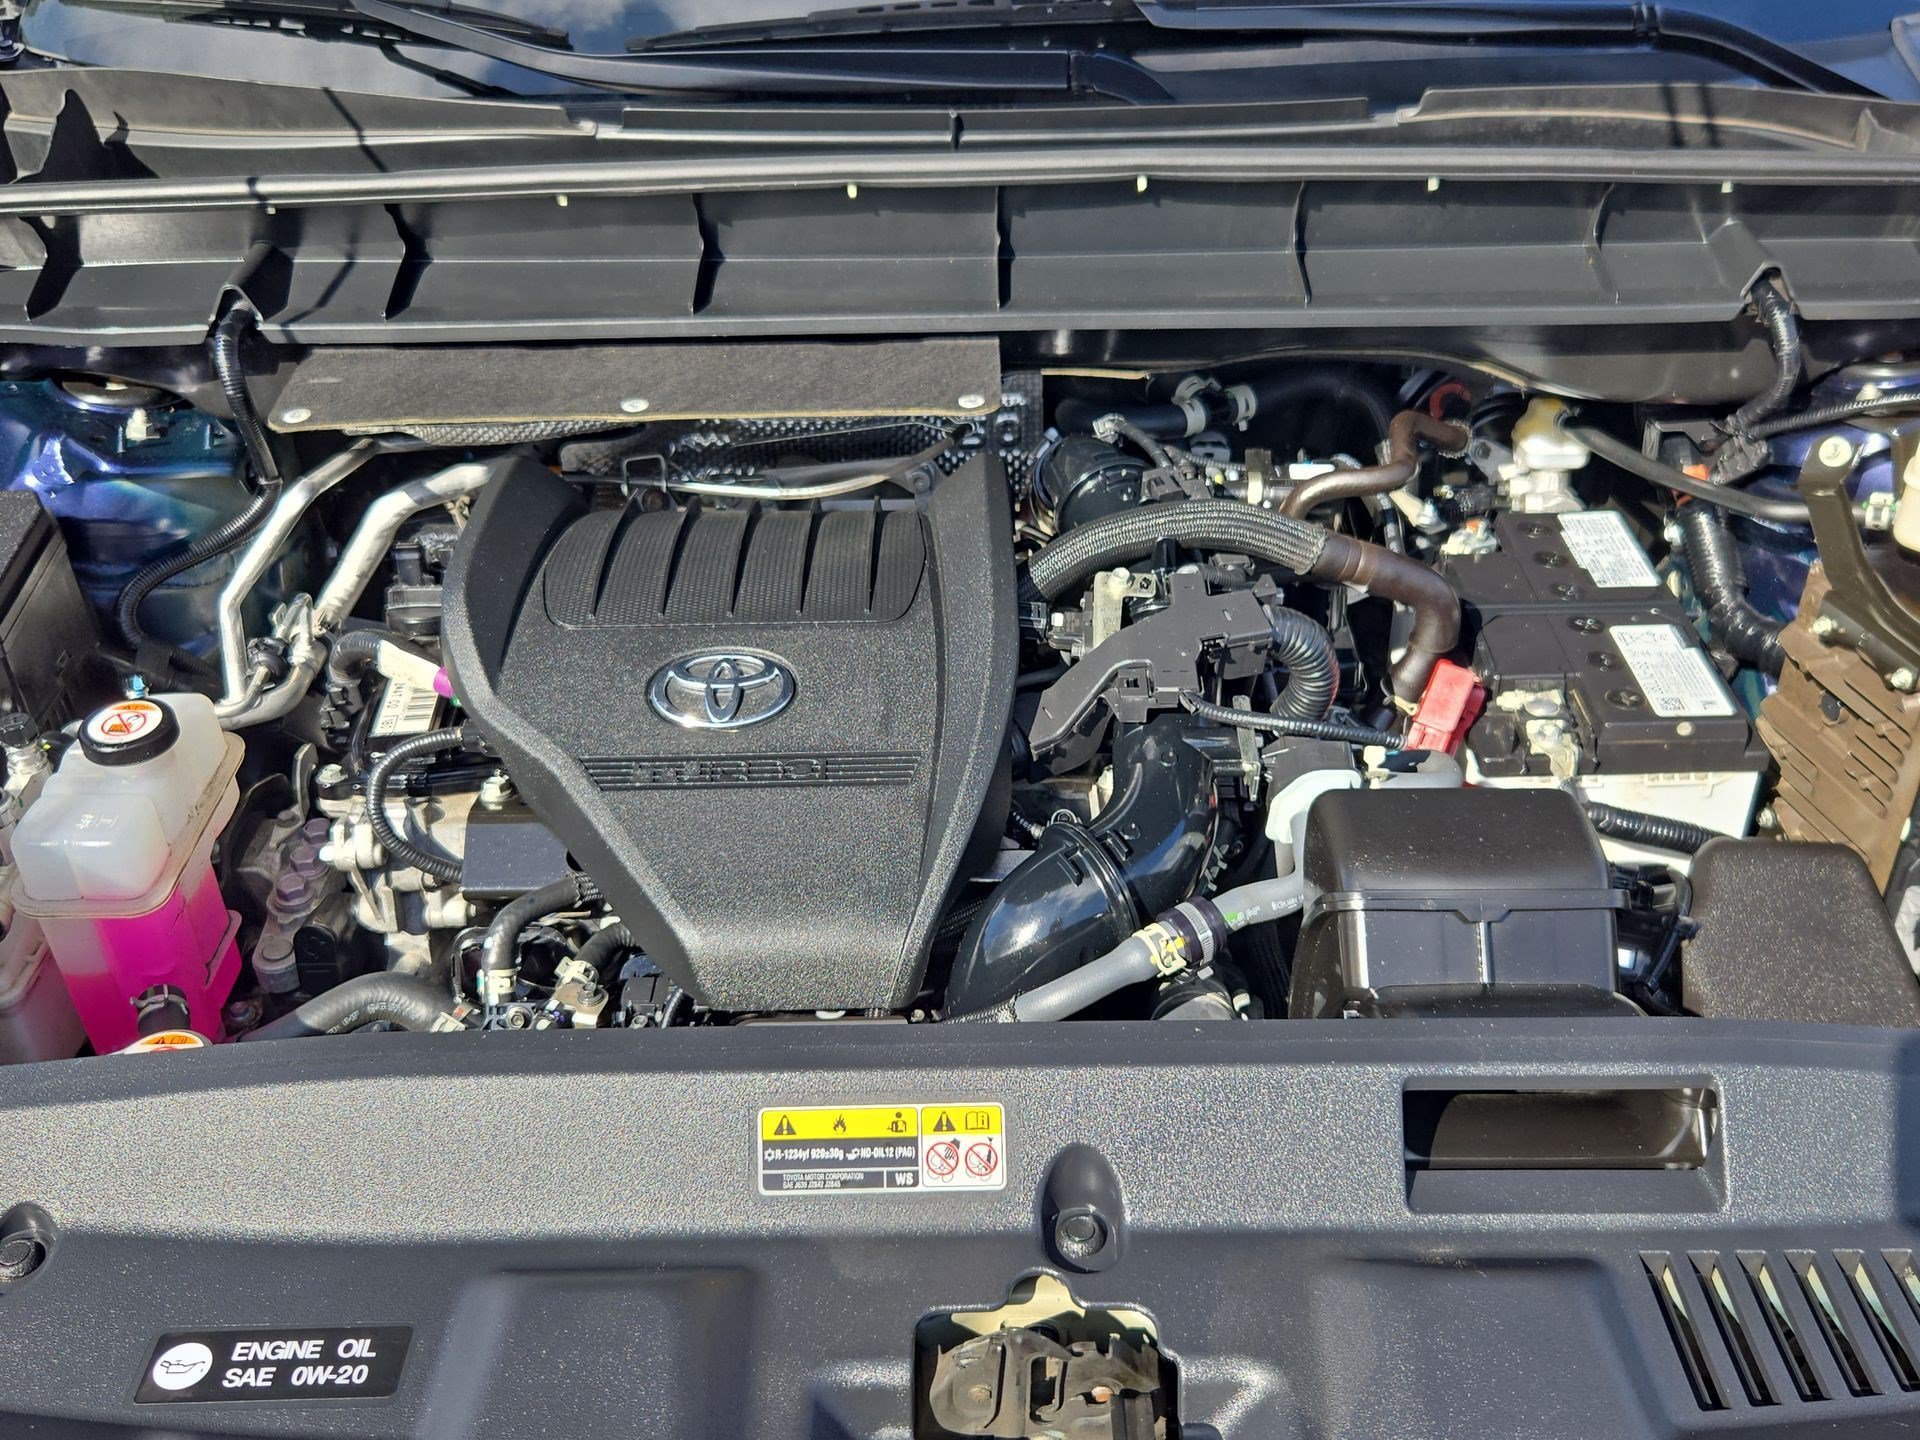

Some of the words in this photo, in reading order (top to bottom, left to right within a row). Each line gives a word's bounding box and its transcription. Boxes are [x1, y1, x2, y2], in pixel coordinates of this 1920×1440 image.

[895, 1146, 916, 1160] (PAG)
[783, 1173, 804, 1181] TOYOTA
[805, 1173, 825, 1181] MOTOR
[825, 1172, 864, 1181] CORPORATION
[894, 1172, 914, 1186] WS
[231, 1340, 324, 1361] ENGINE
[337, 1338, 377, 1358] OIL
[222, 1366, 276, 1388] SAE
[291, 1364, 369, 1386] 0W-20
